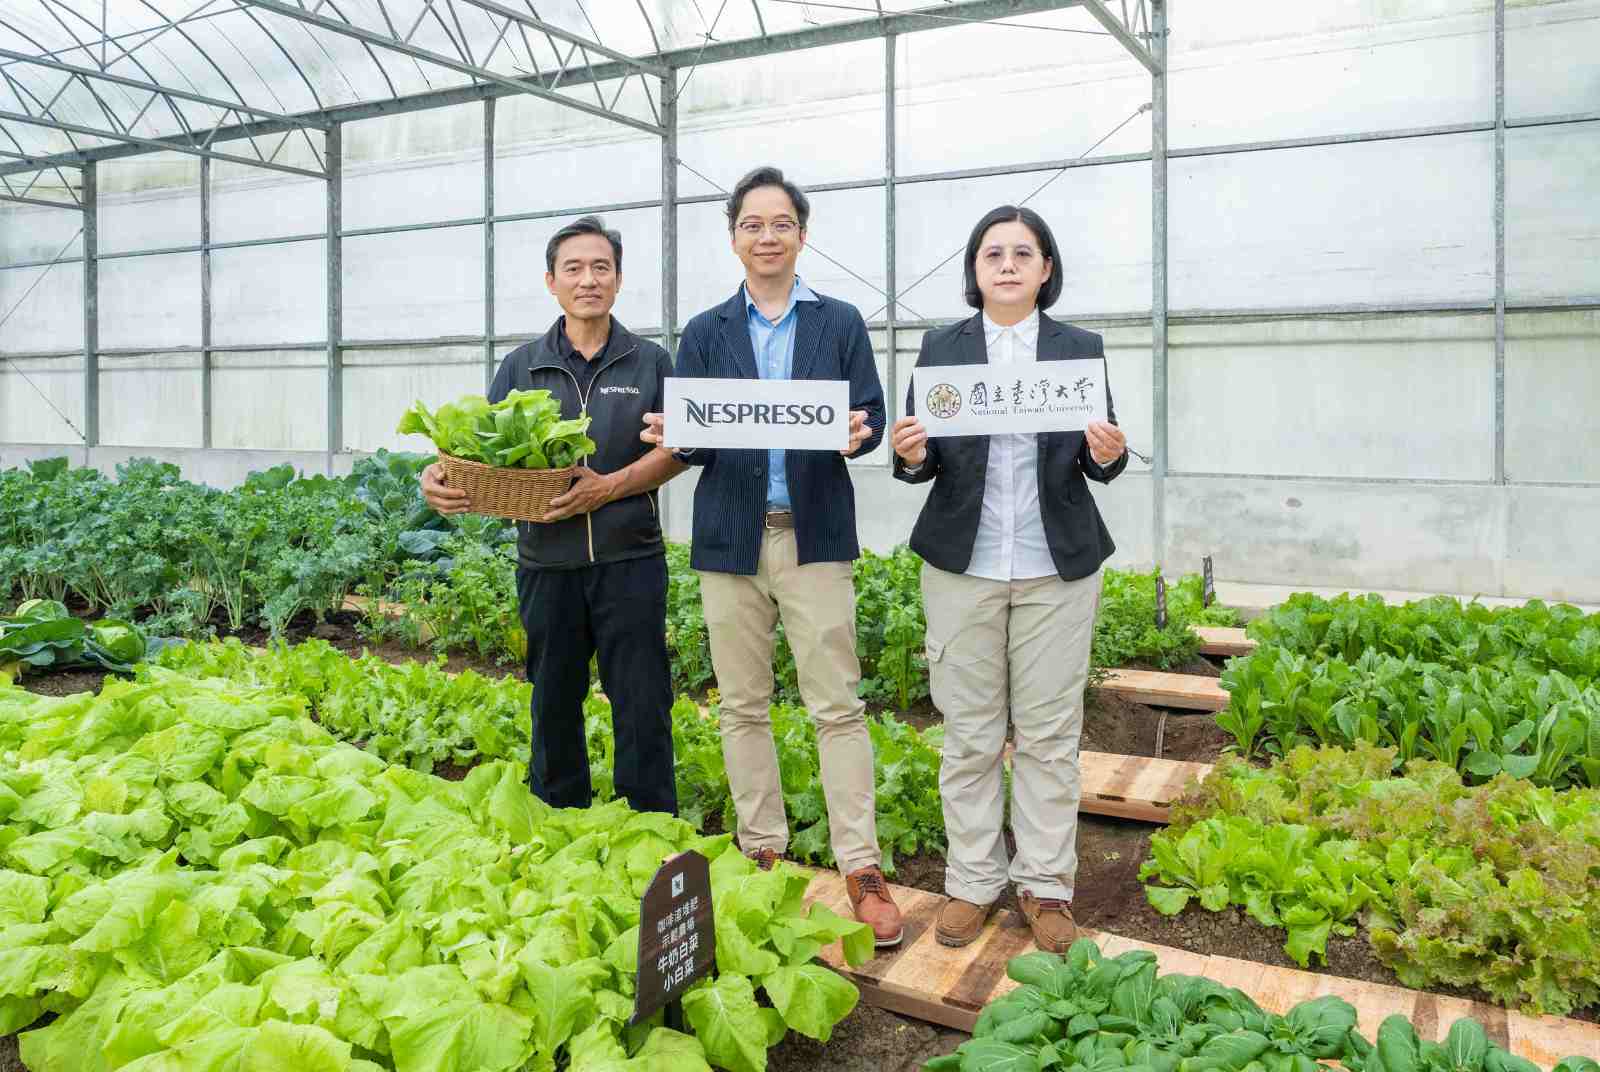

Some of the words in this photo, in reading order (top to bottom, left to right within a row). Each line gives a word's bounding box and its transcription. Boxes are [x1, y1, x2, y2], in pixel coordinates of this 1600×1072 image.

[680, 398, 835, 428] NESPRESSO
[968, 406, 1008, 417] National
[1013, 405, 1045, 415] Taiwan
[1047, 403, 1094, 416] University
[657, 932, 699, 974] 牛奶白菜
[663, 956, 694, 993] 小白菜
